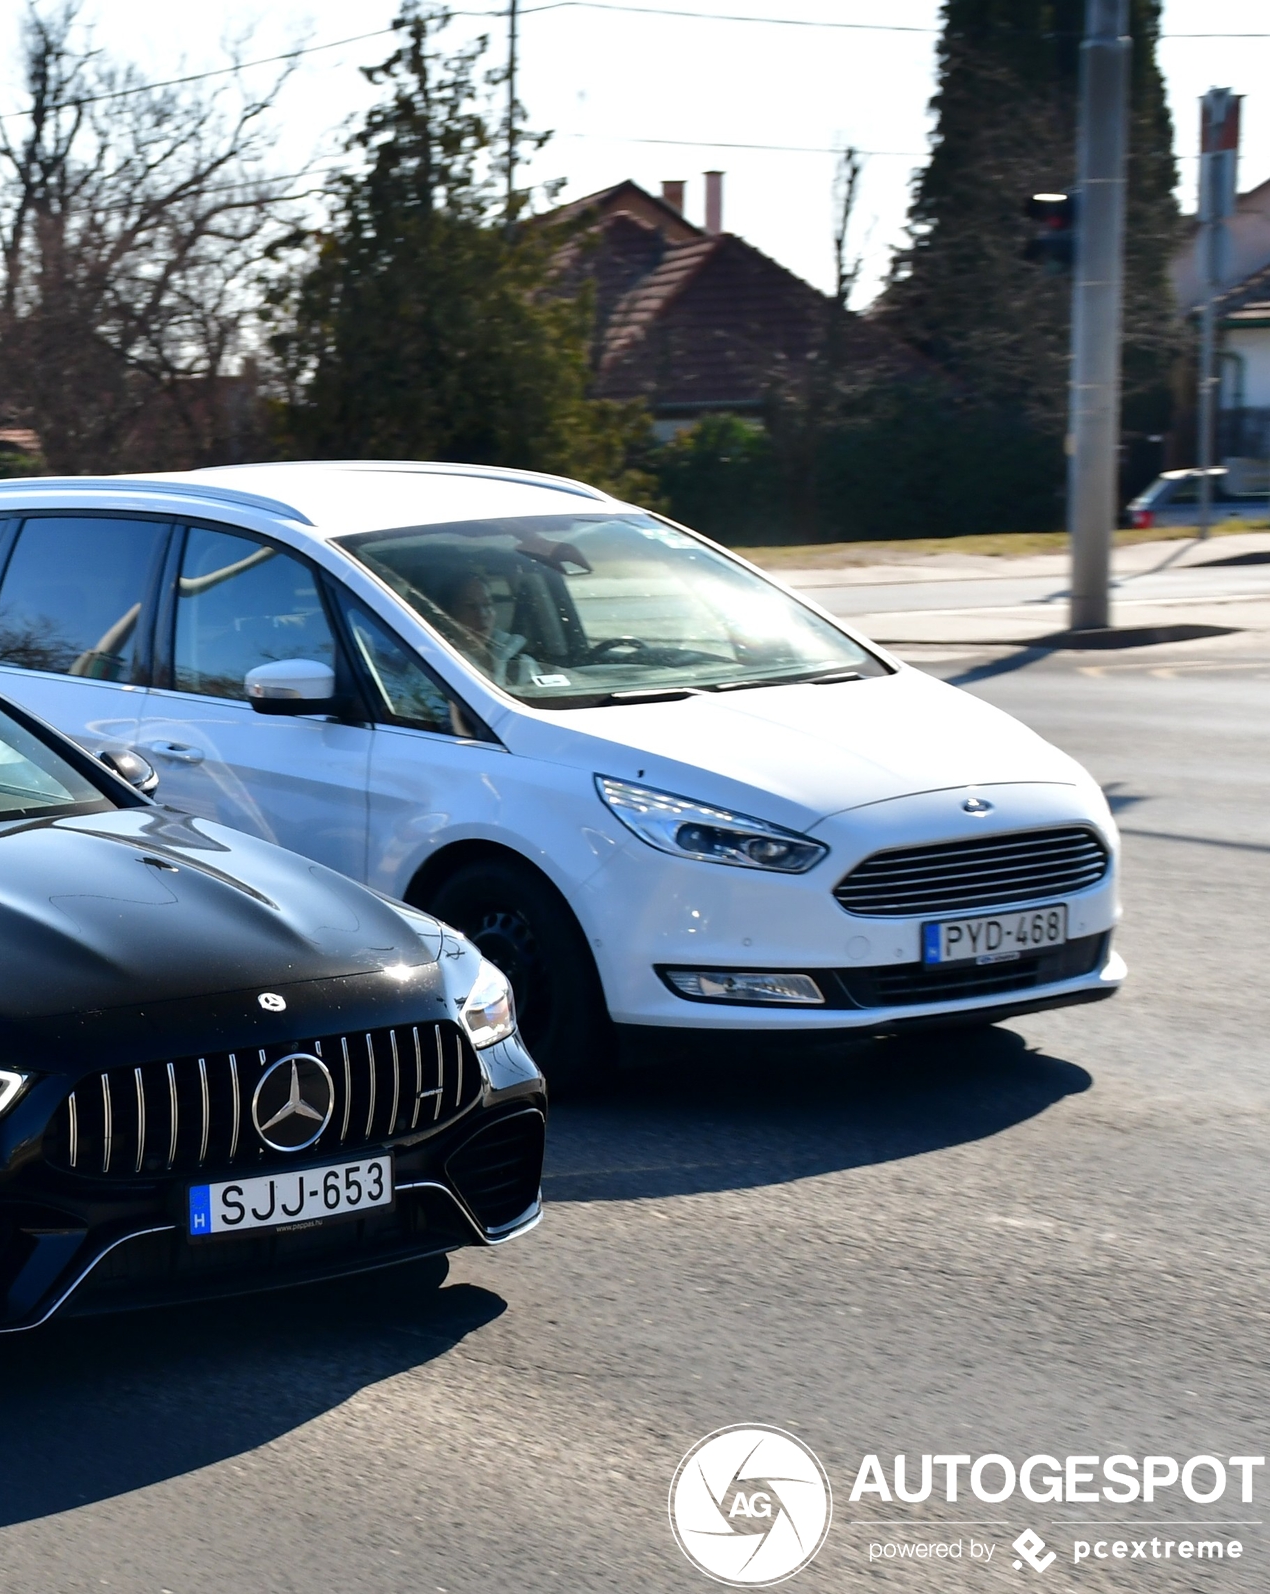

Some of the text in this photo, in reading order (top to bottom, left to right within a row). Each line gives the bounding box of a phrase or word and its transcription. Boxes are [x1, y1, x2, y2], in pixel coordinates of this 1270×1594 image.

[946, 912, 1059, 956] PYD-468
[221, 1162, 384, 1225] SJJ-653
[194, 1213, 206, 1228] H
